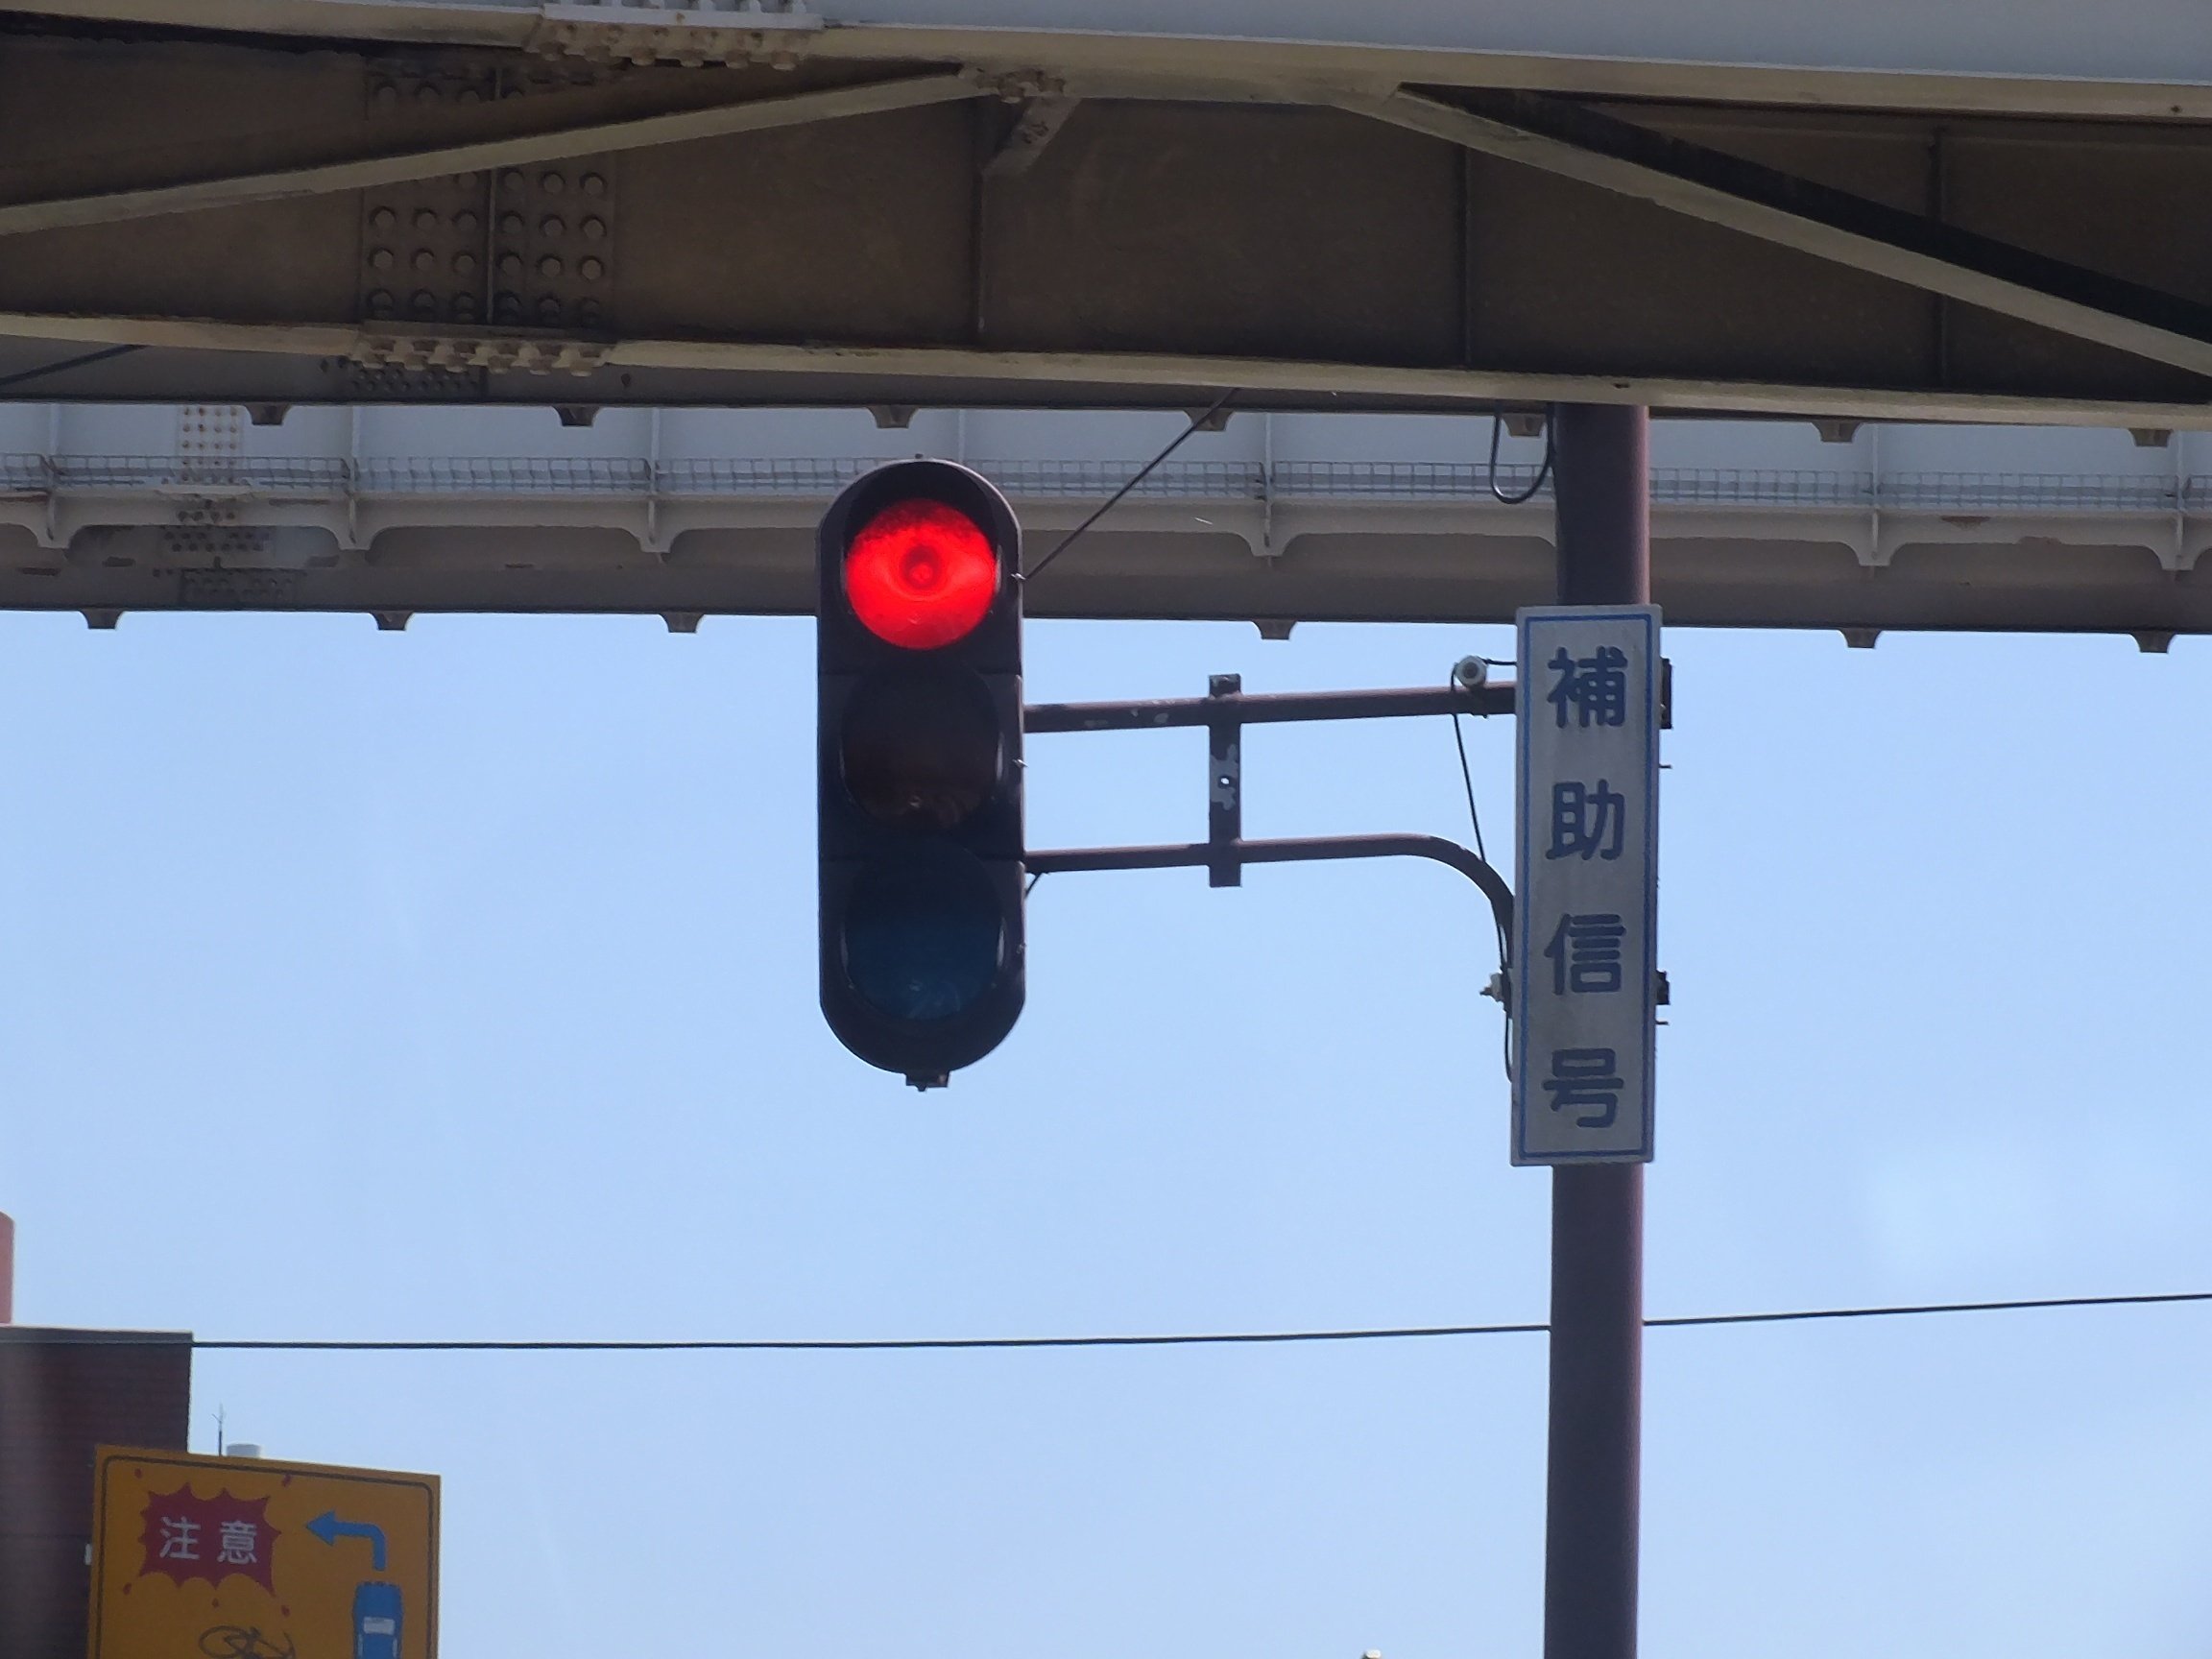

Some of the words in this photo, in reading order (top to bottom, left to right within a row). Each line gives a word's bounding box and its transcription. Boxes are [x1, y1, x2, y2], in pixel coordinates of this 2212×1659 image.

[1542, 646, 1628, 1128] 補助信号
[159, 1515, 258, 1565] 注意
